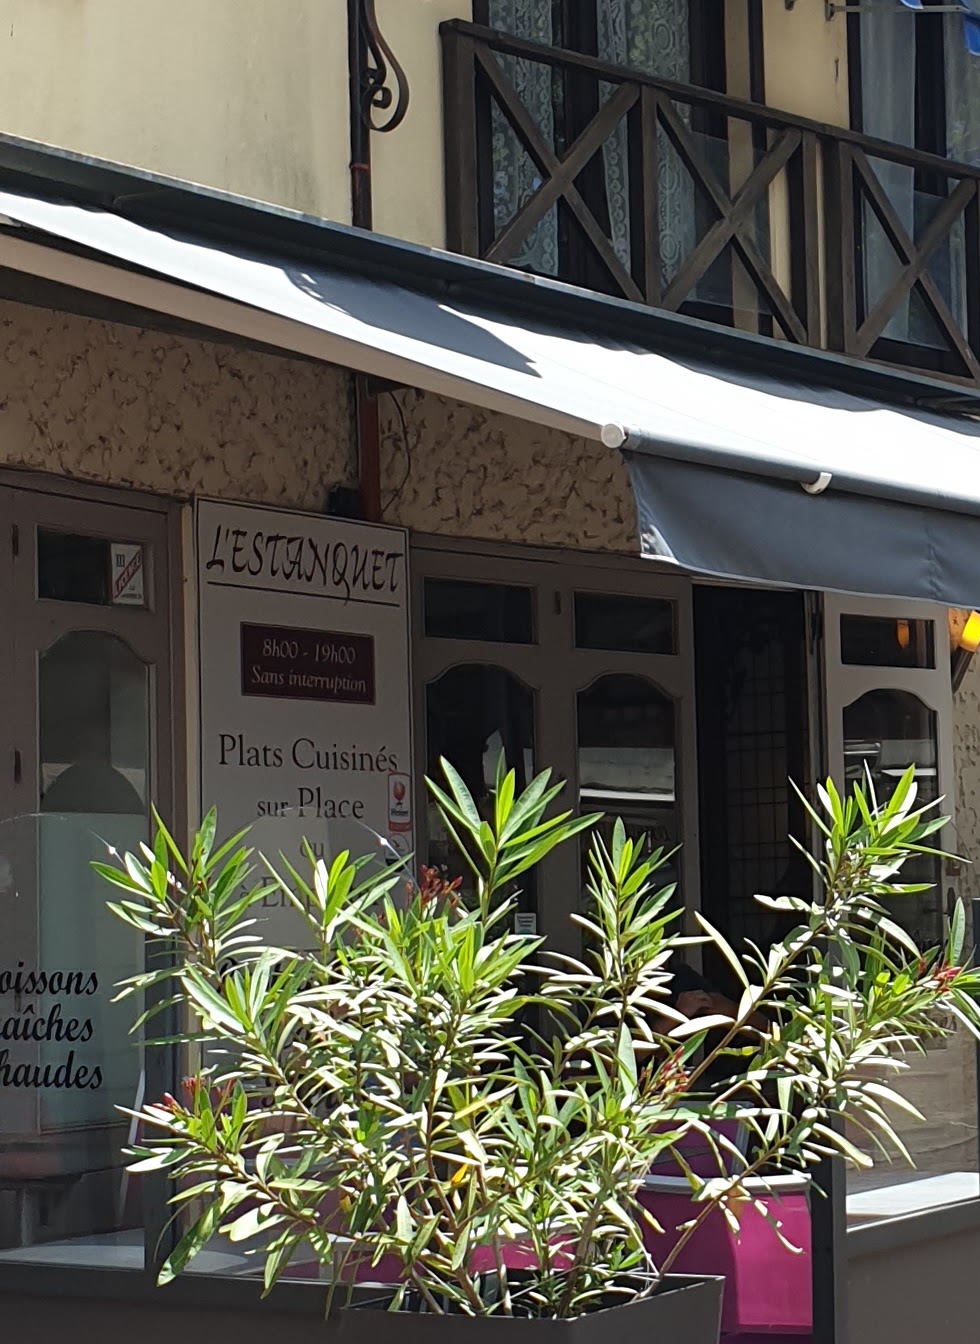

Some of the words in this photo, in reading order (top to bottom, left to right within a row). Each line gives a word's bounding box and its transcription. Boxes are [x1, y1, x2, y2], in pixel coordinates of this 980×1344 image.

[206, 524, 404, 605] L'ESTANQUET
[262, 638, 299, 659] 8h00
[314, 643, 356, 665] 19h00
[251, 665, 285, 686] Sans
[288, 669, 367, 694] interruption
[218, 733, 284, 768] Plats
[291, 738, 399, 773] Cuisinés
[257, 799, 289, 817] sur
[297, 786, 365, 819] Place
